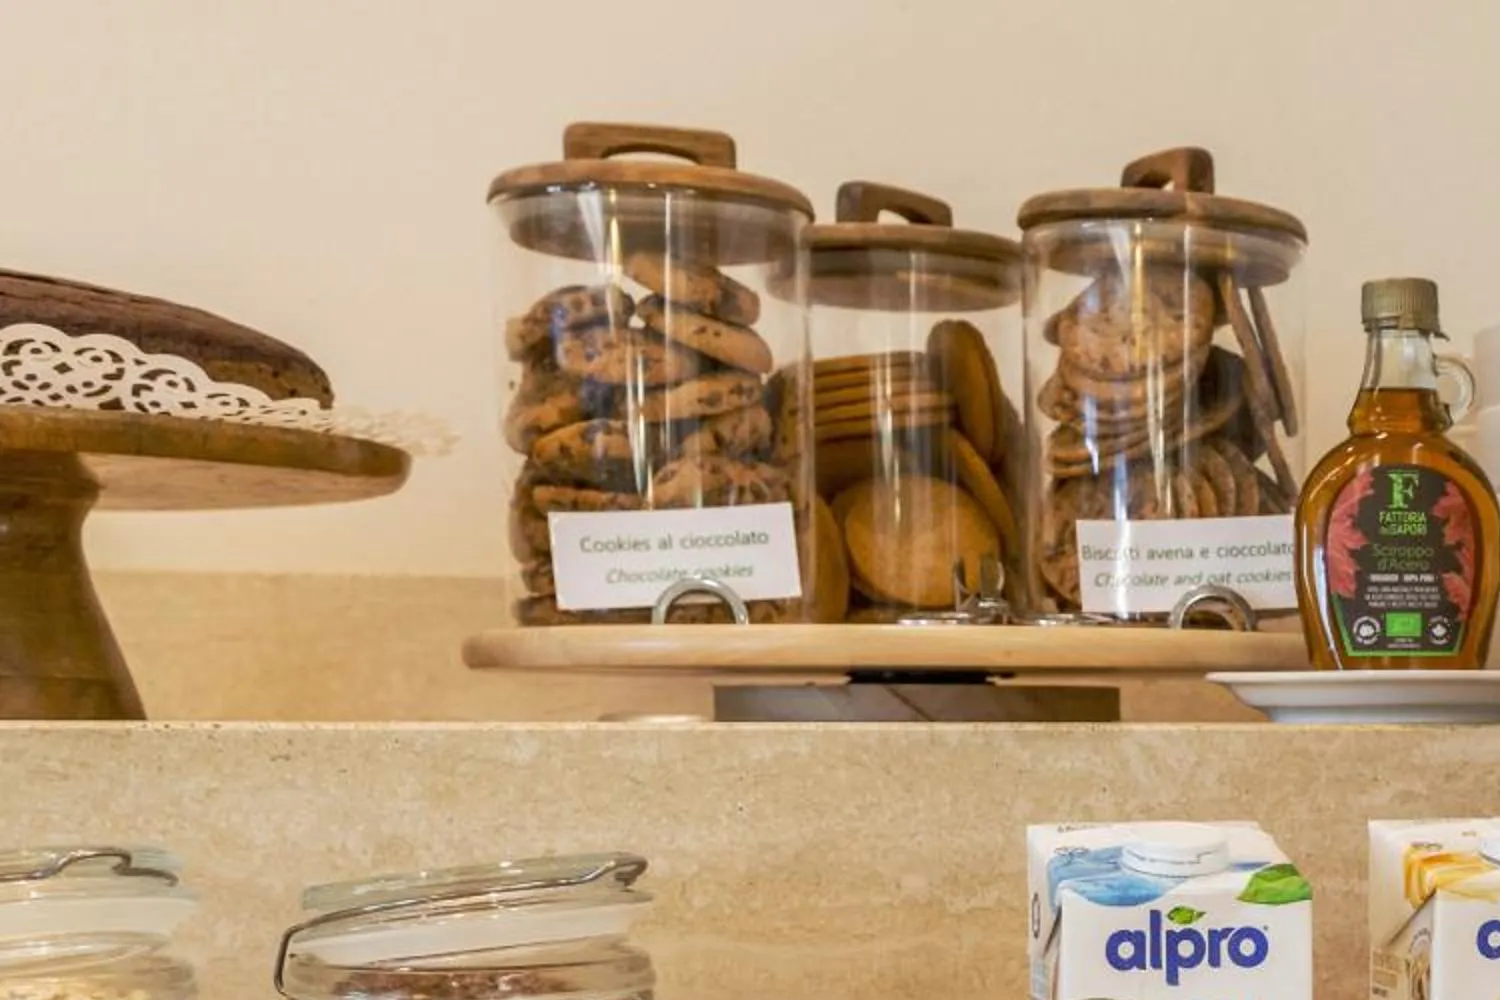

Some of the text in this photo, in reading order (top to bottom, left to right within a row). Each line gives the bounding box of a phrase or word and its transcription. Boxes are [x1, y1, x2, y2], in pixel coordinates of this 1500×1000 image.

[578, 530, 769, 553] Cookies al cioccolato
[1147, 546, 1194, 561] avena
[1199, 546, 1210, 559] e
[1105, 909, 1269, 986] alpro
